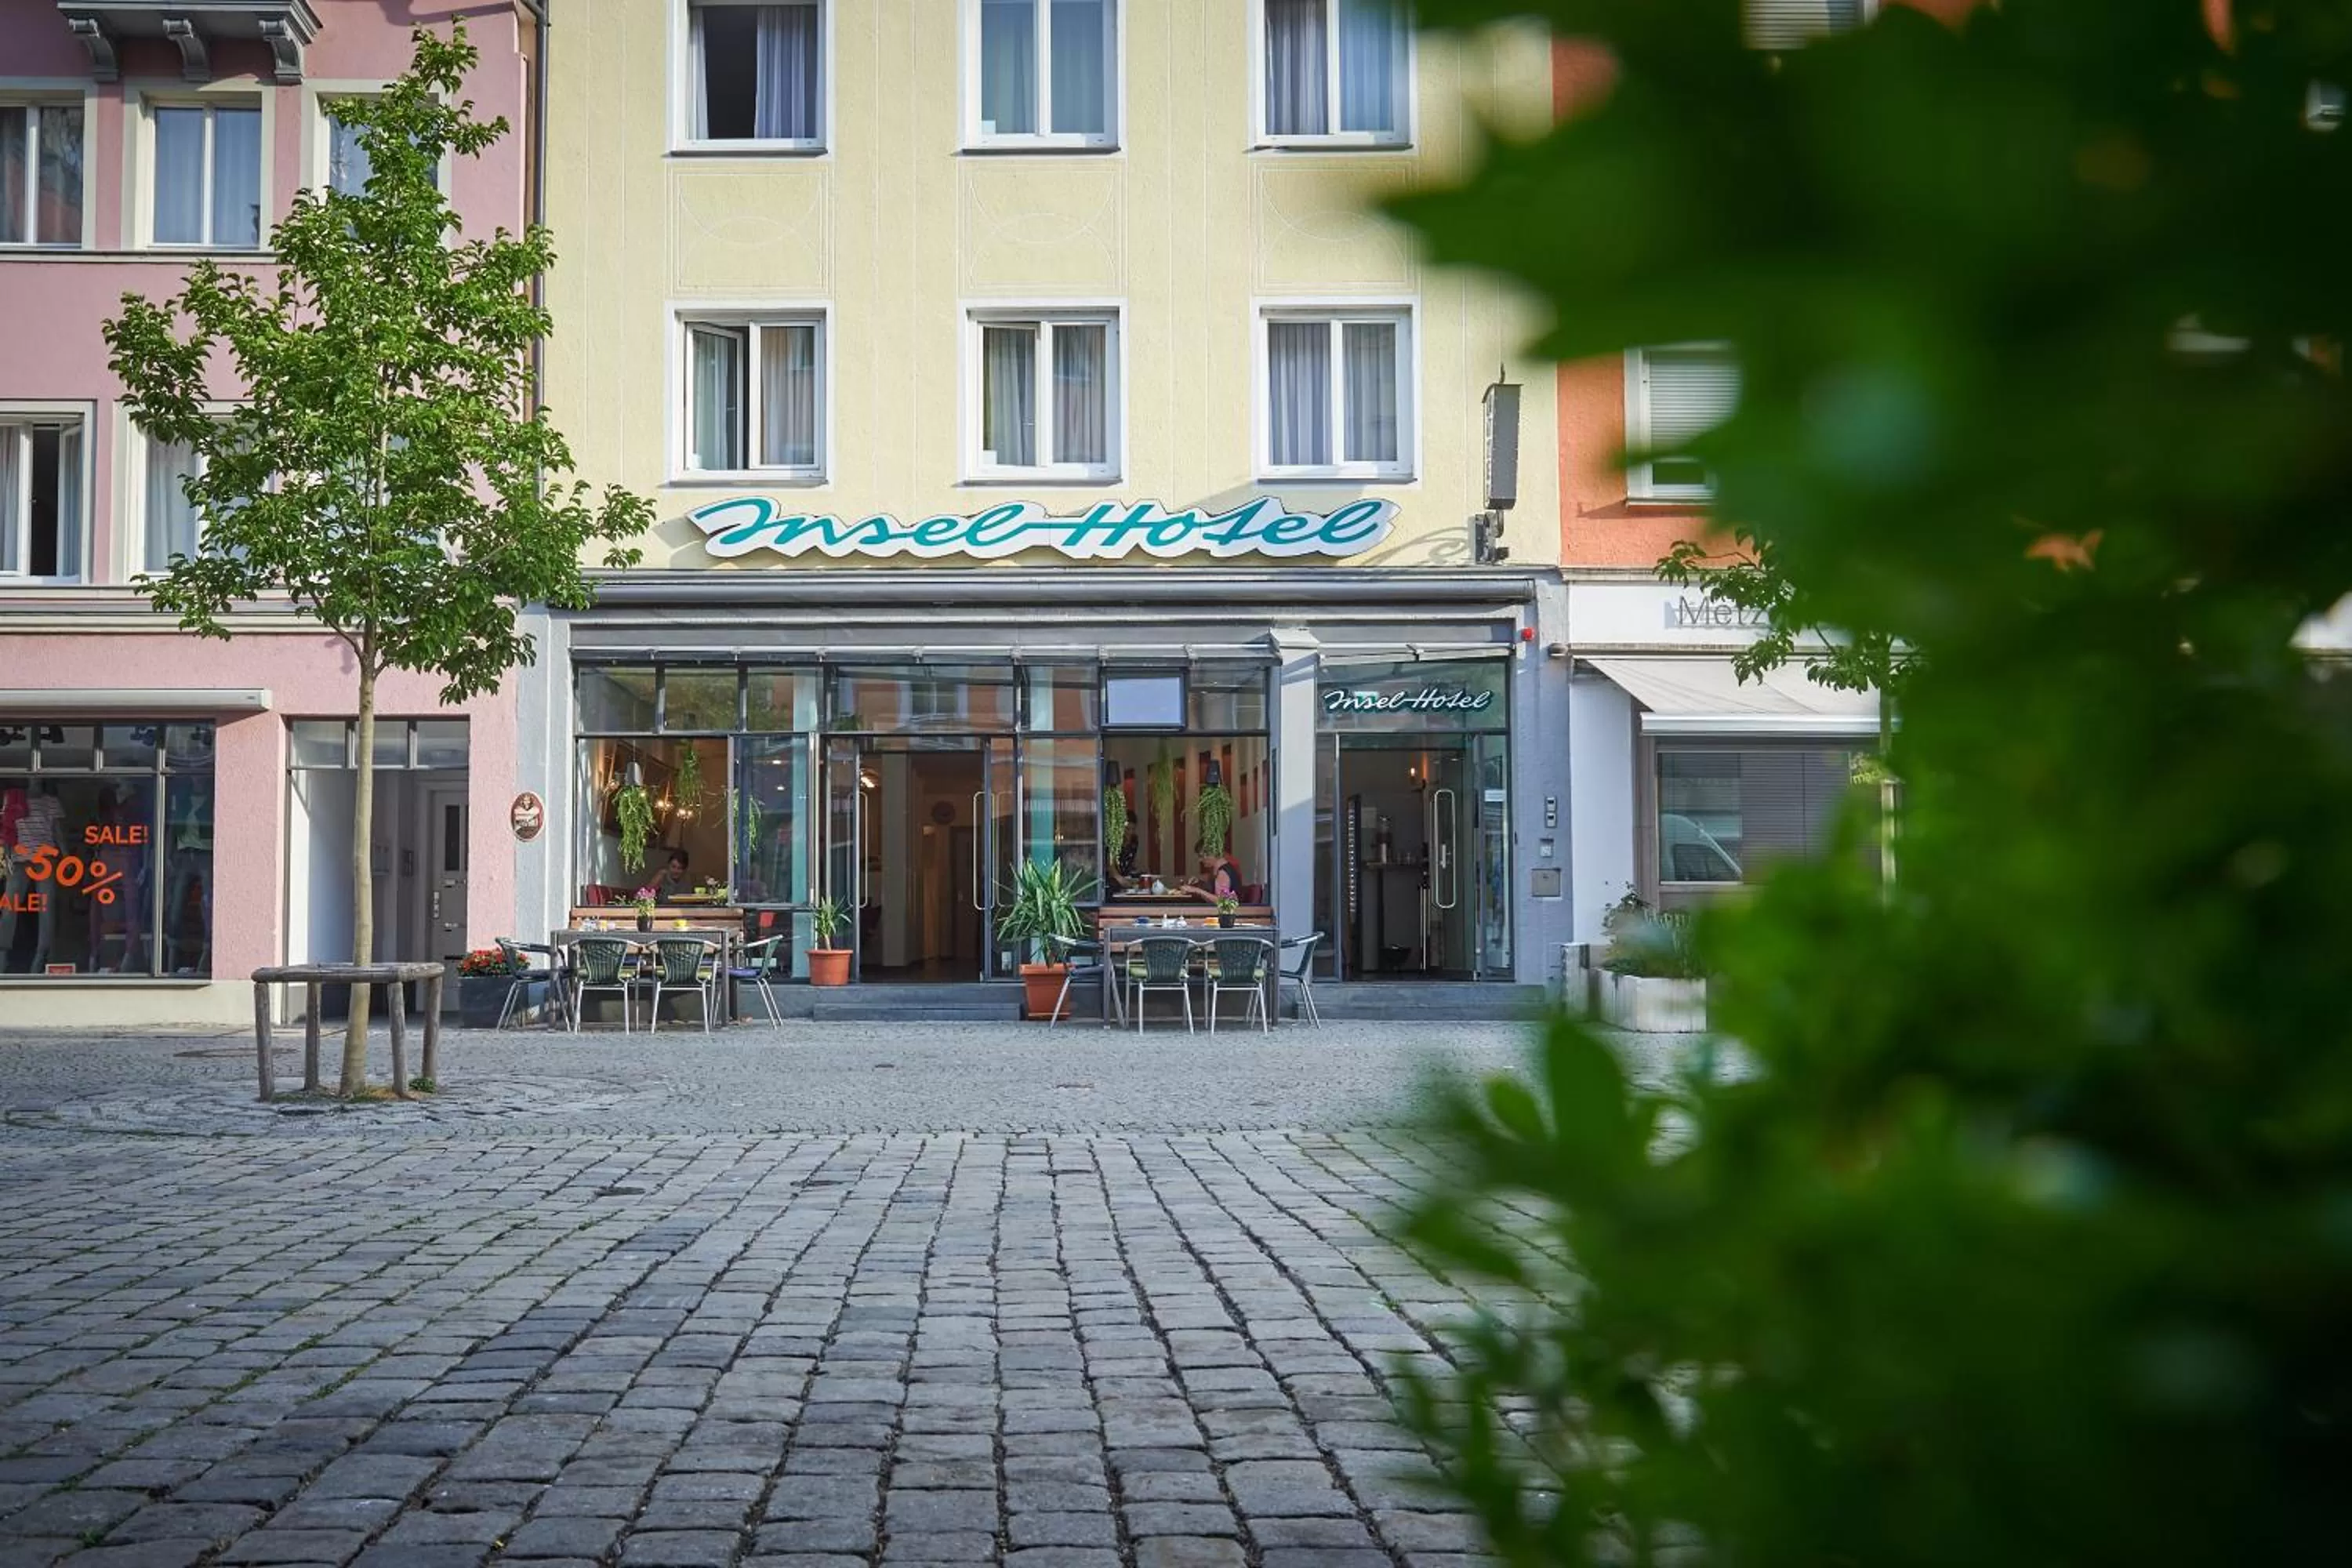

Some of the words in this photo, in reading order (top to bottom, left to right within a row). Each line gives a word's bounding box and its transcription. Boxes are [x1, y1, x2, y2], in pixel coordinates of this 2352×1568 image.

[1679, 595, 1769, 625] Metz
[85, 825, 149, 844] SALE!
[0, 893, 48, 912] ALE!
